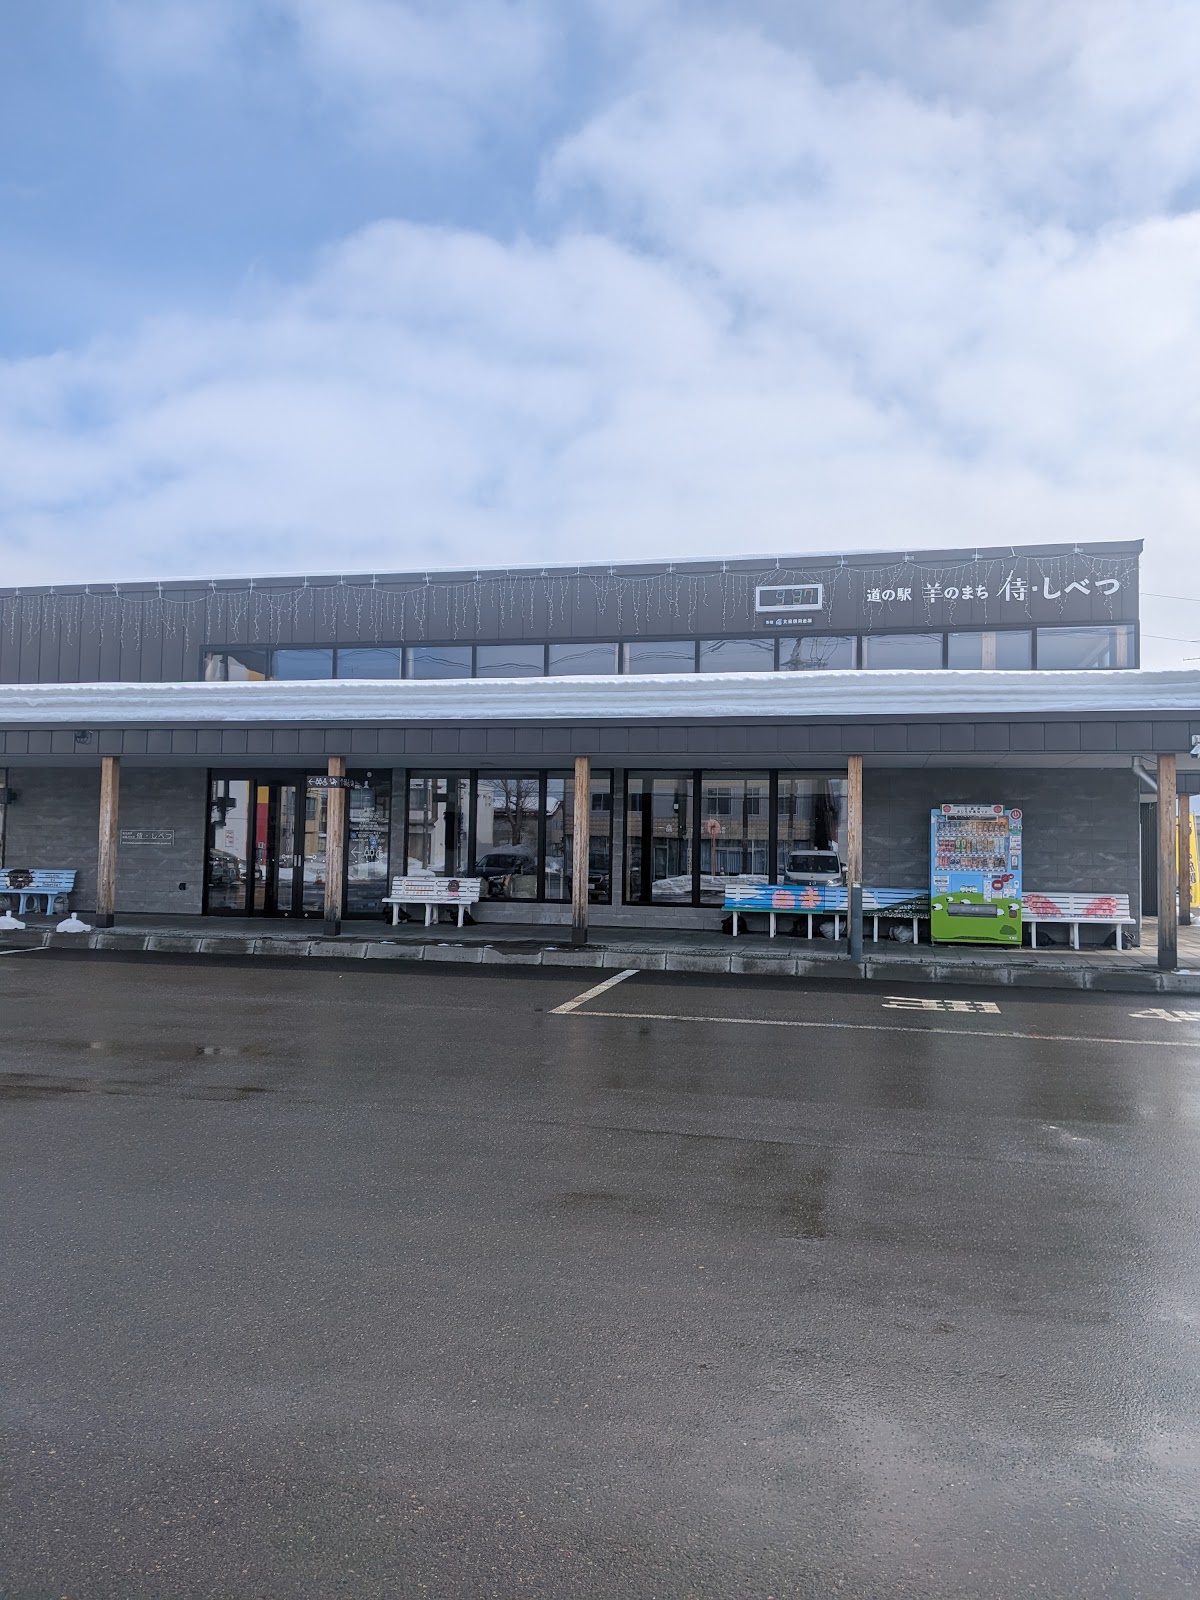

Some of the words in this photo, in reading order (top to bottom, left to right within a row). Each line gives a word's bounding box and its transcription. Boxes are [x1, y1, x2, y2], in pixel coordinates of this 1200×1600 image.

[867, 587, 912, 602] 道の駅
[923, 582, 989, 603] 羊のまち
